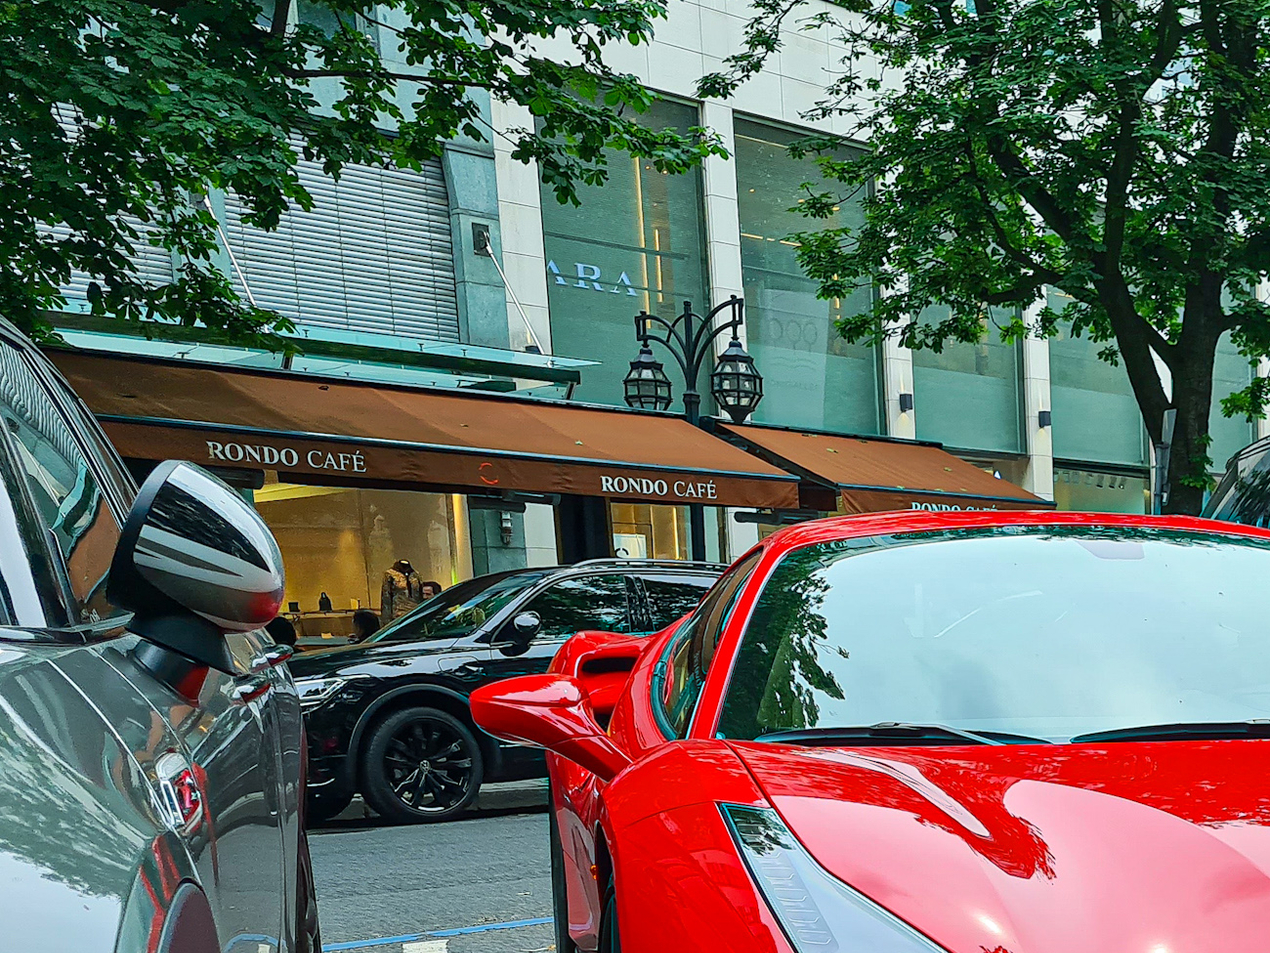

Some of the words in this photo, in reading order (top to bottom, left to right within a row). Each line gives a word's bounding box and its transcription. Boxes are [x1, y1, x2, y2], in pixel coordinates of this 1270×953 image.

[206, 441, 299, 467] RONDO
[307, 450, 367, 473] CAFÉ
[600, 475, 668, 496] RONDO
[673, 480, 717, 499] CAFÉ
